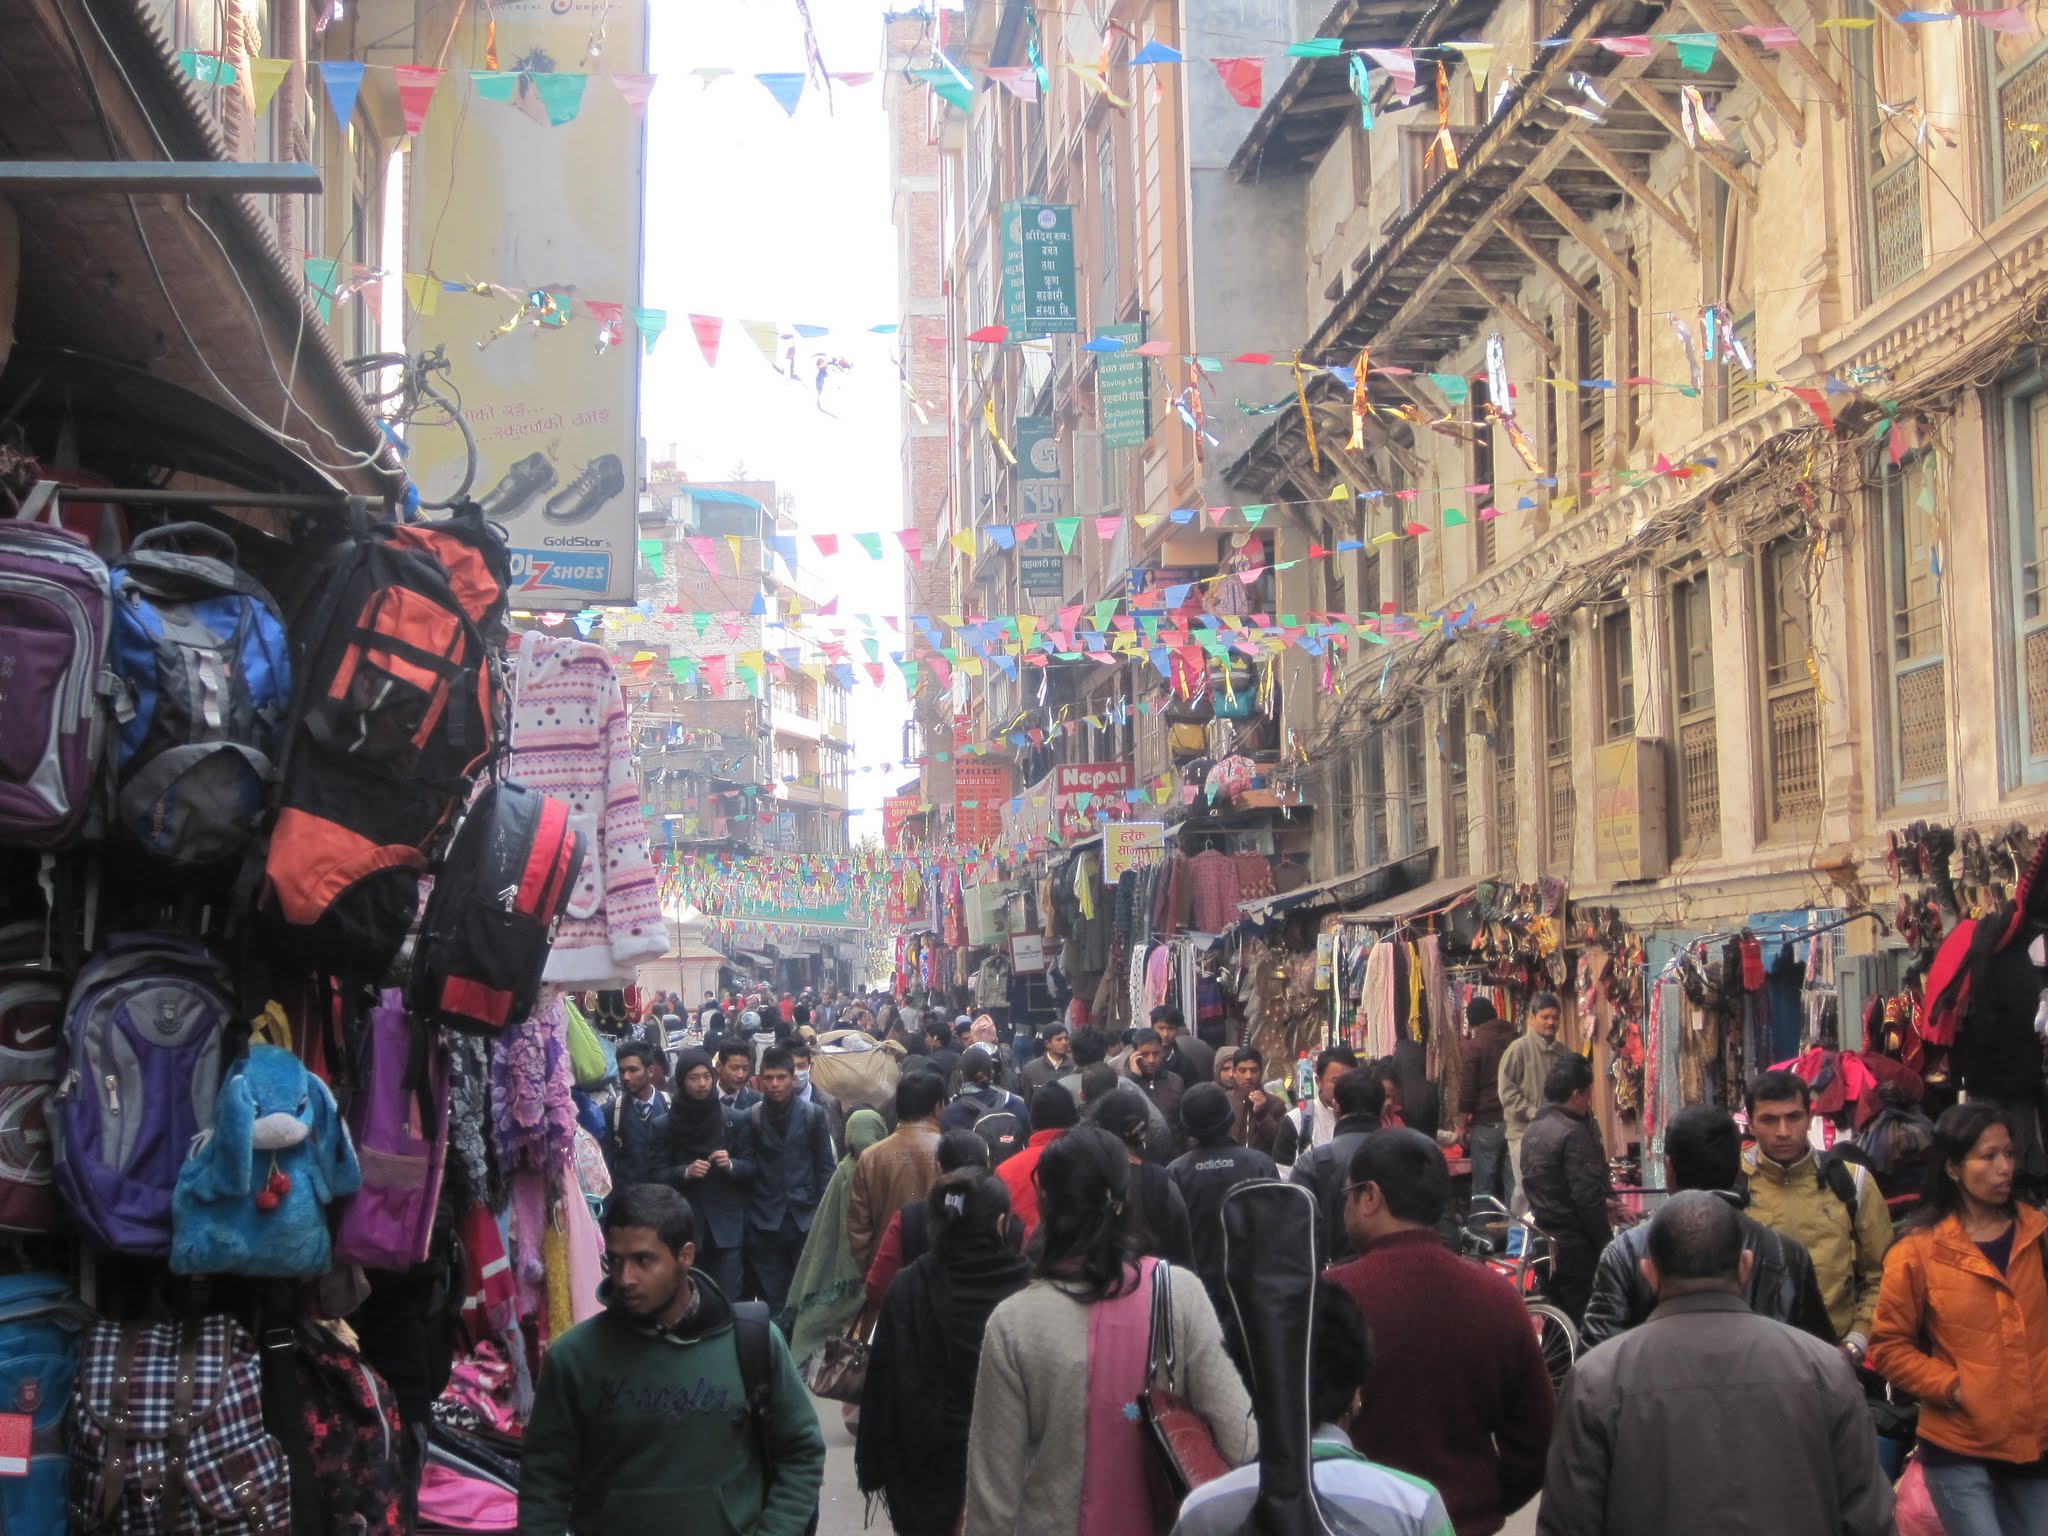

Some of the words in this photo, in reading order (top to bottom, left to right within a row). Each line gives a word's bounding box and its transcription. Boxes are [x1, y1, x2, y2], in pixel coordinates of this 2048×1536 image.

[1101, 379, 1126, 388] Saving
[551, 565, 605, 579] SHOES
[955, 768, 1001, 776] PRICE
[1062, 766, 1127, 790] Nepal
[886, 800, 917, 808] FESTIVAL
[1120, 828, 1147, 842] हरेक
[1195, 1158, 1235, 1171] adidas
